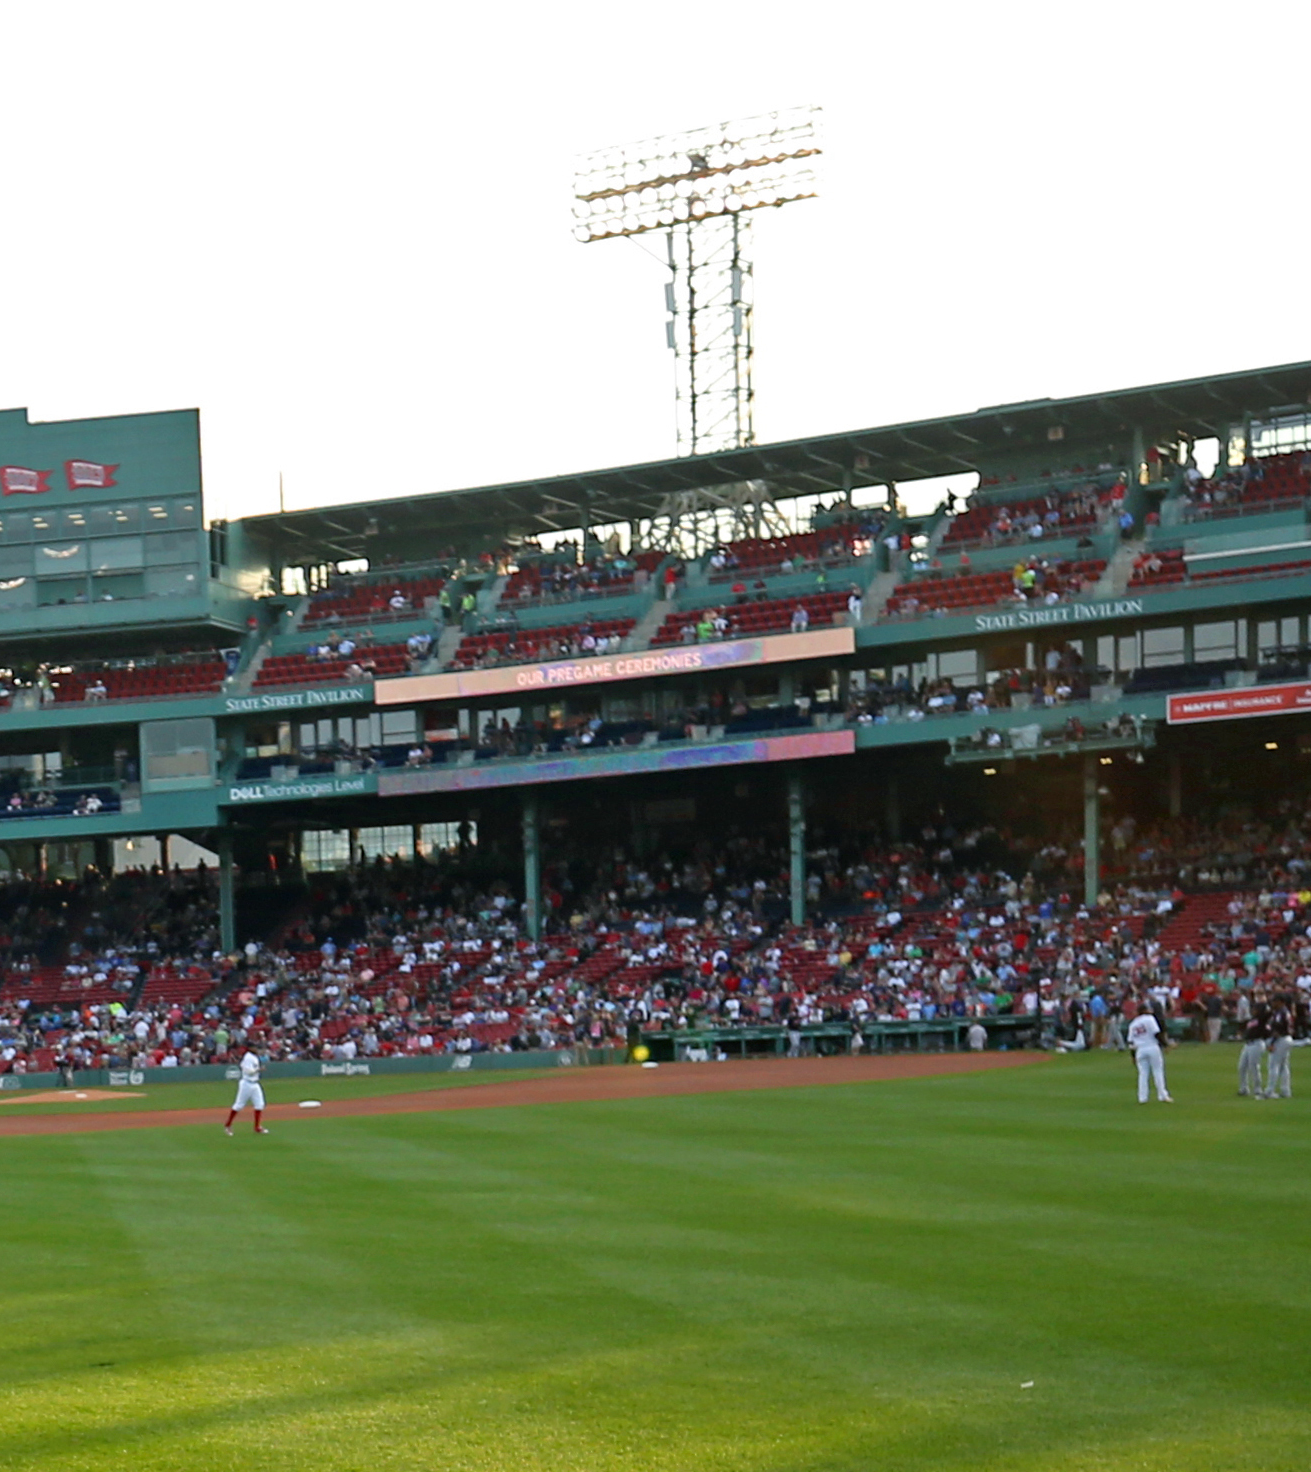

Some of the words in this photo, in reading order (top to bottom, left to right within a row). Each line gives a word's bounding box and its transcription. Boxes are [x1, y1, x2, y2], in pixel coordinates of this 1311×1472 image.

[976, 615, 1017, 631] STATE
[1018, 607, 1069, 626] STREET
[1073, 599, 1144, 620] PAVILION
[516, 670, 544, 687] OUR
[547, 661, 612, 682] PREGAME
[616, 653, 704, 674] CEREMONIES
[230, 786, 264, 800] DELL
[334, 778, 365, 791] Level
